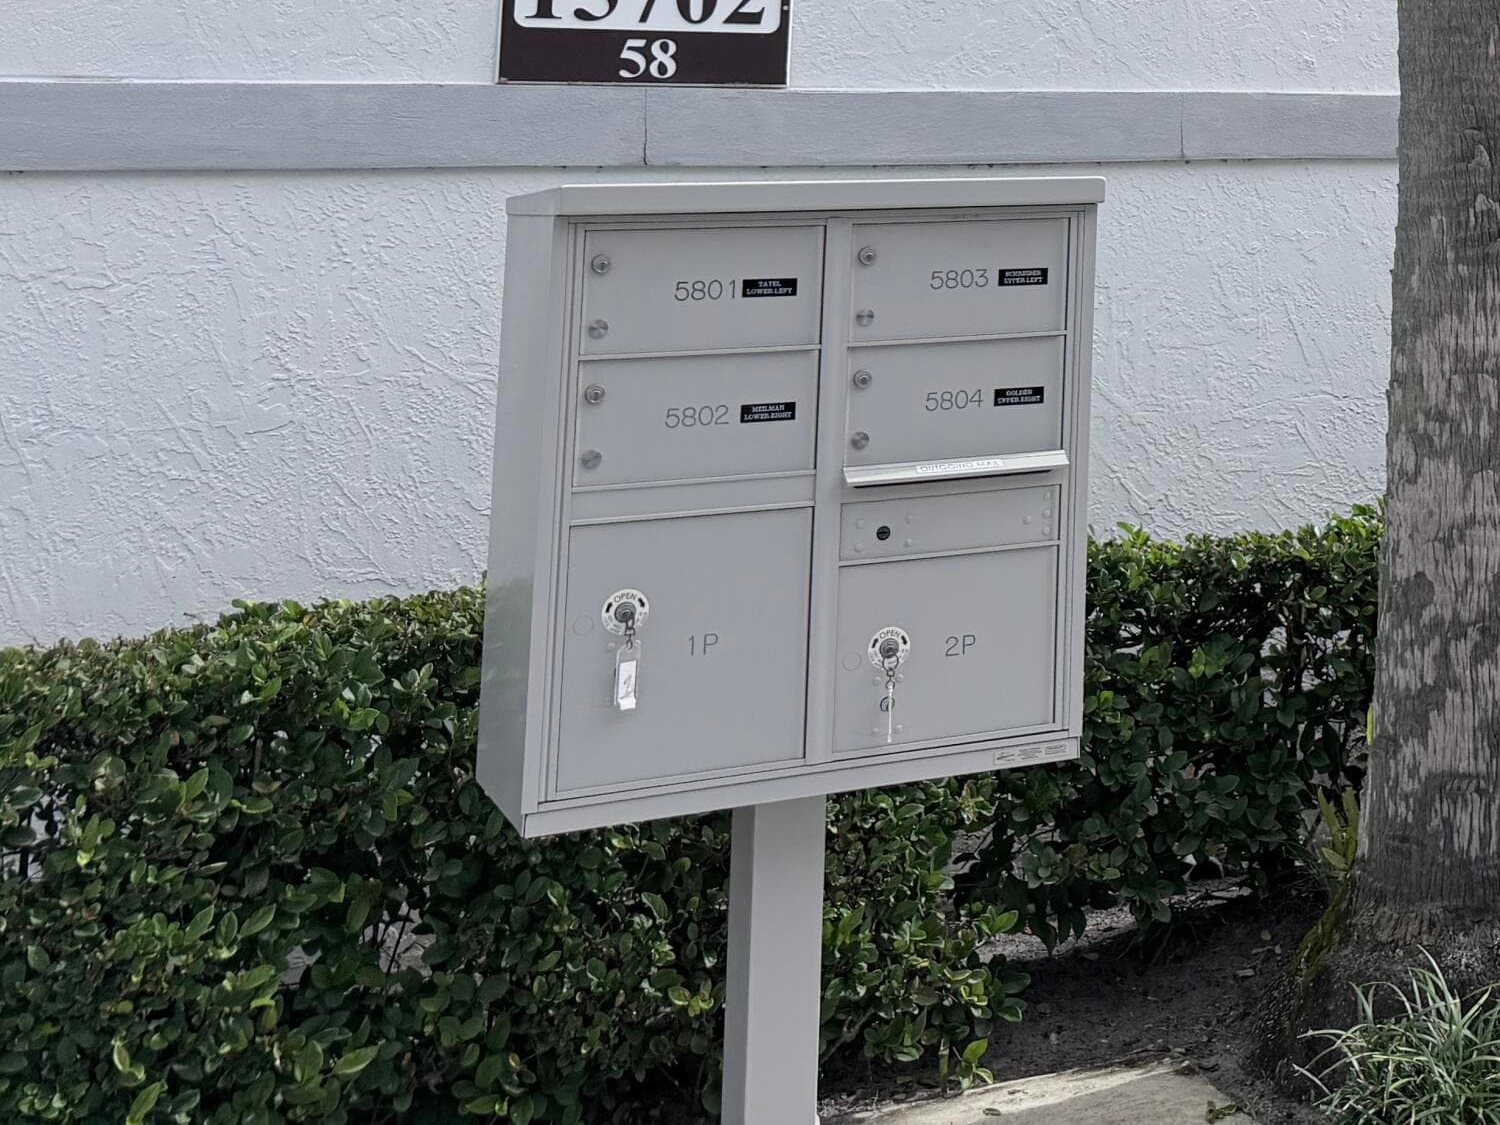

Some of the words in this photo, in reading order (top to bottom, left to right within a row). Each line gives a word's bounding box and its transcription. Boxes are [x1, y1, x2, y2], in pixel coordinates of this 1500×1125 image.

[618, 38, 678, 79] 58
[673, 279, 737, 302] 5801
[929, 268, 990, 290] 5803
[924, 388, 984, 412] 5804
[664, 404, 730, 429] 5802
[743, 412, 770, 420] LOWER
[919, 461, 973, 473] OUTGOING
[613, 592, 637, 603] OPEN
[688, 633, 719, 657] 1P
[879, 629, 901, 639] OPEN
[944, 634, 976, 658] 2P
